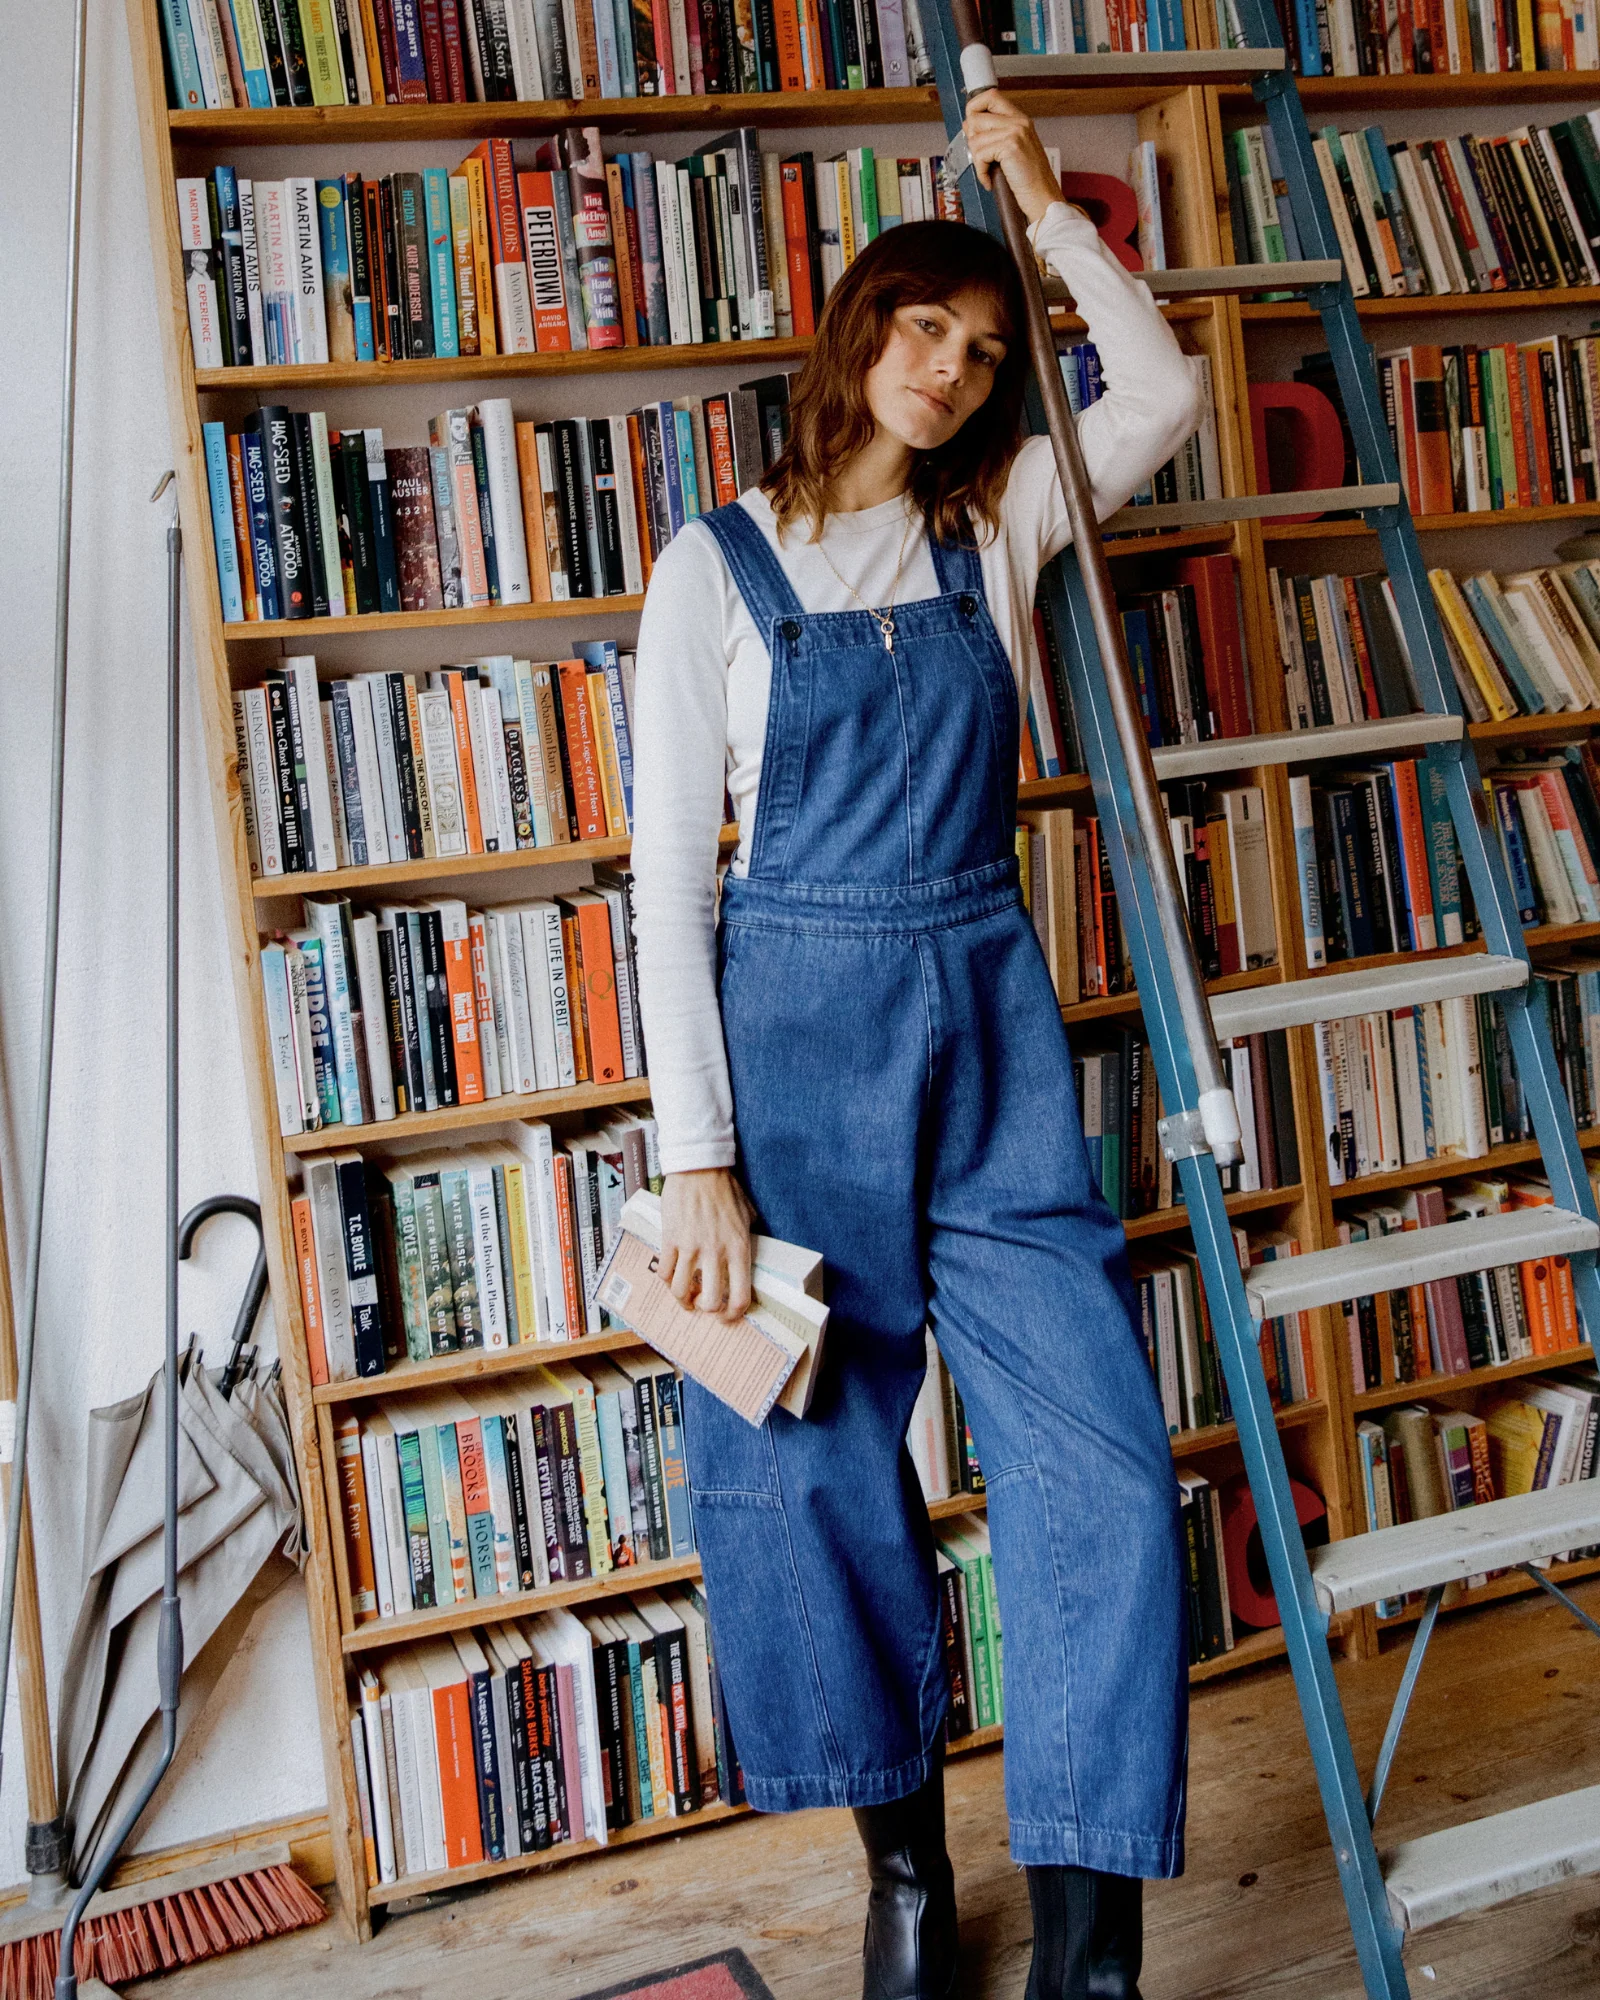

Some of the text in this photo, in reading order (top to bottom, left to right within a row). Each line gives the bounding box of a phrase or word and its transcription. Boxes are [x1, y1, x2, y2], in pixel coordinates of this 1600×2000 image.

[176, 32, 191, 79] Ghosts
[404, 4, 417, 57] OF SAINTS
[475, 11, 490, 78] ELVIRA NAVARRO
[550, 17, 564, 75] untold story
[782, 10, 794, 60] RIPPER
[315, 36, 331, 81] THREE SHEETS
[493, 42, 508, 79] Story
[188, 189, 201, 245] MARTIN AMIS
[224, 177, 235, 228] Night Train
[403, 190, 415, 226] HEYDAY
[495, 146, 518, 252] PRIMARY COLORS
[584, 196, 602, 206] Tina
[750, 183, 762, 213] LIES
[296, 188, 315, 295] MARTIN AMIS
[354, 208, 363, 253] GOLDEN
[587, 228, 606, 239] Ansa
[356, 258, 365, 279] AGE
[407, 245, 422, 321] KURT ANDERSEN
[460, 266, 473, 297] Maud
[527, 211, 562, 306] PETERDOWN
[626, 212, 635, 239] enter
[631, 261, 640, 304] aardvark
[197, 284, 211, 343] EXPERIENCE
[231, 256, 245, 320] MARTIN AMIS
[462, 300, 476, 338] Dixon?
[271, 420, 290, 484] HAG-SEED
[664, 412, 678, 486] The Golden Chariot
[710, 407, 728, 449] EMPIRE
[213, 441, 227, 514] Case Histories
[247, 447, 266, 503] HAG-SEED
[392, 489, 428, 497] AUSTER
[436, 453, 452, 538] PAUL AUSTER INVISIBLE
[561, 429, 577, 520] HOLDEN'S PERFORMANCE
[584, 485, 592, 506] FIRST
[720, 461, 732, 484] SUN
[256, 538, 271, 587] ATWOOD
[280, 524, 296, 579] ATWOOD
[407, 684, 417, 717] JULIAN
[605, 649, 625, 726] THE GOLDEN CALF
[233, 702, 247, 771] PAT BARKER
[251, 701, 262, 748] SILENCE
[411, 719, 422, 755] BARNES
[539, 692, 557, 775] Sebastian Barry
[258, 762, 268, 794] GIRLS
[276, 718, 290, 792] The Ghost Road
[508, 731, 525, 802] BLACKASS
[576, 686, 598, 817] The Obscure Logic of the Heart
[242, 784, 254, 836] LIFE CLASS
[417, 776, 427, 799] NOISE
[420, 801, 428, 812] OF
[423, 814, 431, 832] TIME
[1364, 788, 1382, 876] RICHARD DOOLING
[1345, 835, 1355, 870] DAYLIGHT
[1350, 872, 1360, 899] SAVING
[1305, 862, 1321, 928] landing
[547, 914, 558, 932] MY
[550, 937, 561, 962] LIFE
[329, 920, 345, 992] THE FREE WORLD
[553, 968, 563, 981] IN
[303, 949, 327, 1048] BRIDGE
[388, 975, 403, 1042] One Hundred
[553, 986, 568, 1028] ORBIT
[315, 1057, 327, 1104] BEUKES
[1130, 1052, 1140, 1081] Lucky
[1132, 1086, 1141, 1107] Man
[452, 1193, 466, 1267] WATER MUSIC
[479, 1204, 498, 1325] All the Broken Places
[303, 1258, 312, 1283] TOOTH
[308, 1306, 316, 1327] CLAW
[356, 1279, 371, 1332] Talk Talk
[1140, 1284, 1150, 1335] HOLLYWOOD
[461, 1434, 480, 1501] BROOKS
[560, 1428, 569, 1455] BROOKS
[665, 1457, 684, 1490] JOE
[341, 1462, 360, 1539] JANE EYRE
[411, 1535, 422, 1581] BROOKE
[420, 1538, 430, 1573] DINAH
[474, 1519, 491, 1572] HORSE
[519, 1524, 528, 1557] MARCH
[521, 1660, 539, 1757] SHANNON BURKE
[607, 1649, 620, 1730] AUGUSTEN BURROUGHS
[477, 1681, 494, 1773] A Legacy of Bones
[539, 1699, 552, 1746] yesterday
[531, 1764, 546, 1831] BLACK FLIES
